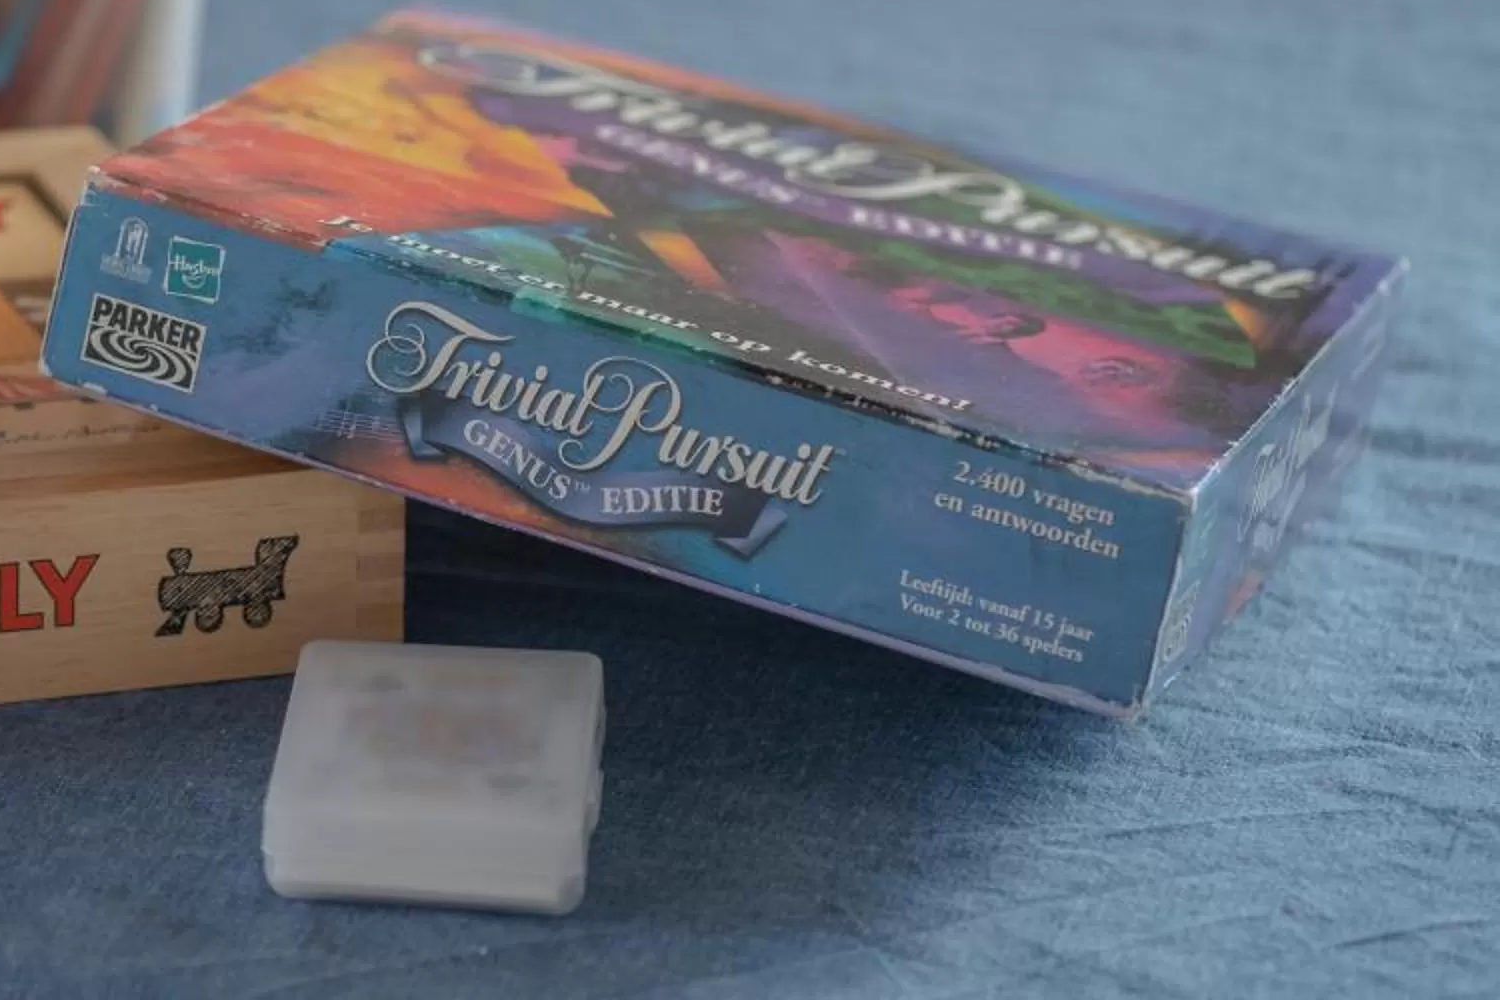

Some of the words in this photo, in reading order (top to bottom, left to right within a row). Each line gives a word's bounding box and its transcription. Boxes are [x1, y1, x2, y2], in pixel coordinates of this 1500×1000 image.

[92, 294, 201, 353] PARKER
[387, 234, 504, 274] moet
[576, 291, 700, 330] maar
[709, 330, 772, 353] op
[366, 300, 608, 438] Trivial
[558, 355, 838, 506] Pursuit
[602, 485, 725, 517] EDITIE
[933, 491, 964, 513] en
[970, 502, 1121, 560] antwoorden
[952, 459, 1027, 499] 2.400
[1032, 488, 1116, 527] vragen
[899, 592, 945, 621] Voor
[947, 608, 960, 626] 2
[964, 614, 991, 637] tot
[996, 622, 1020, 645] 36
[1022, 634, 1086, 664] spelers
[979, 597, 1032, 622] vanaf
[1033, 607, 1055, 630] 15
[1056, 616, 1095, 643] jaar
